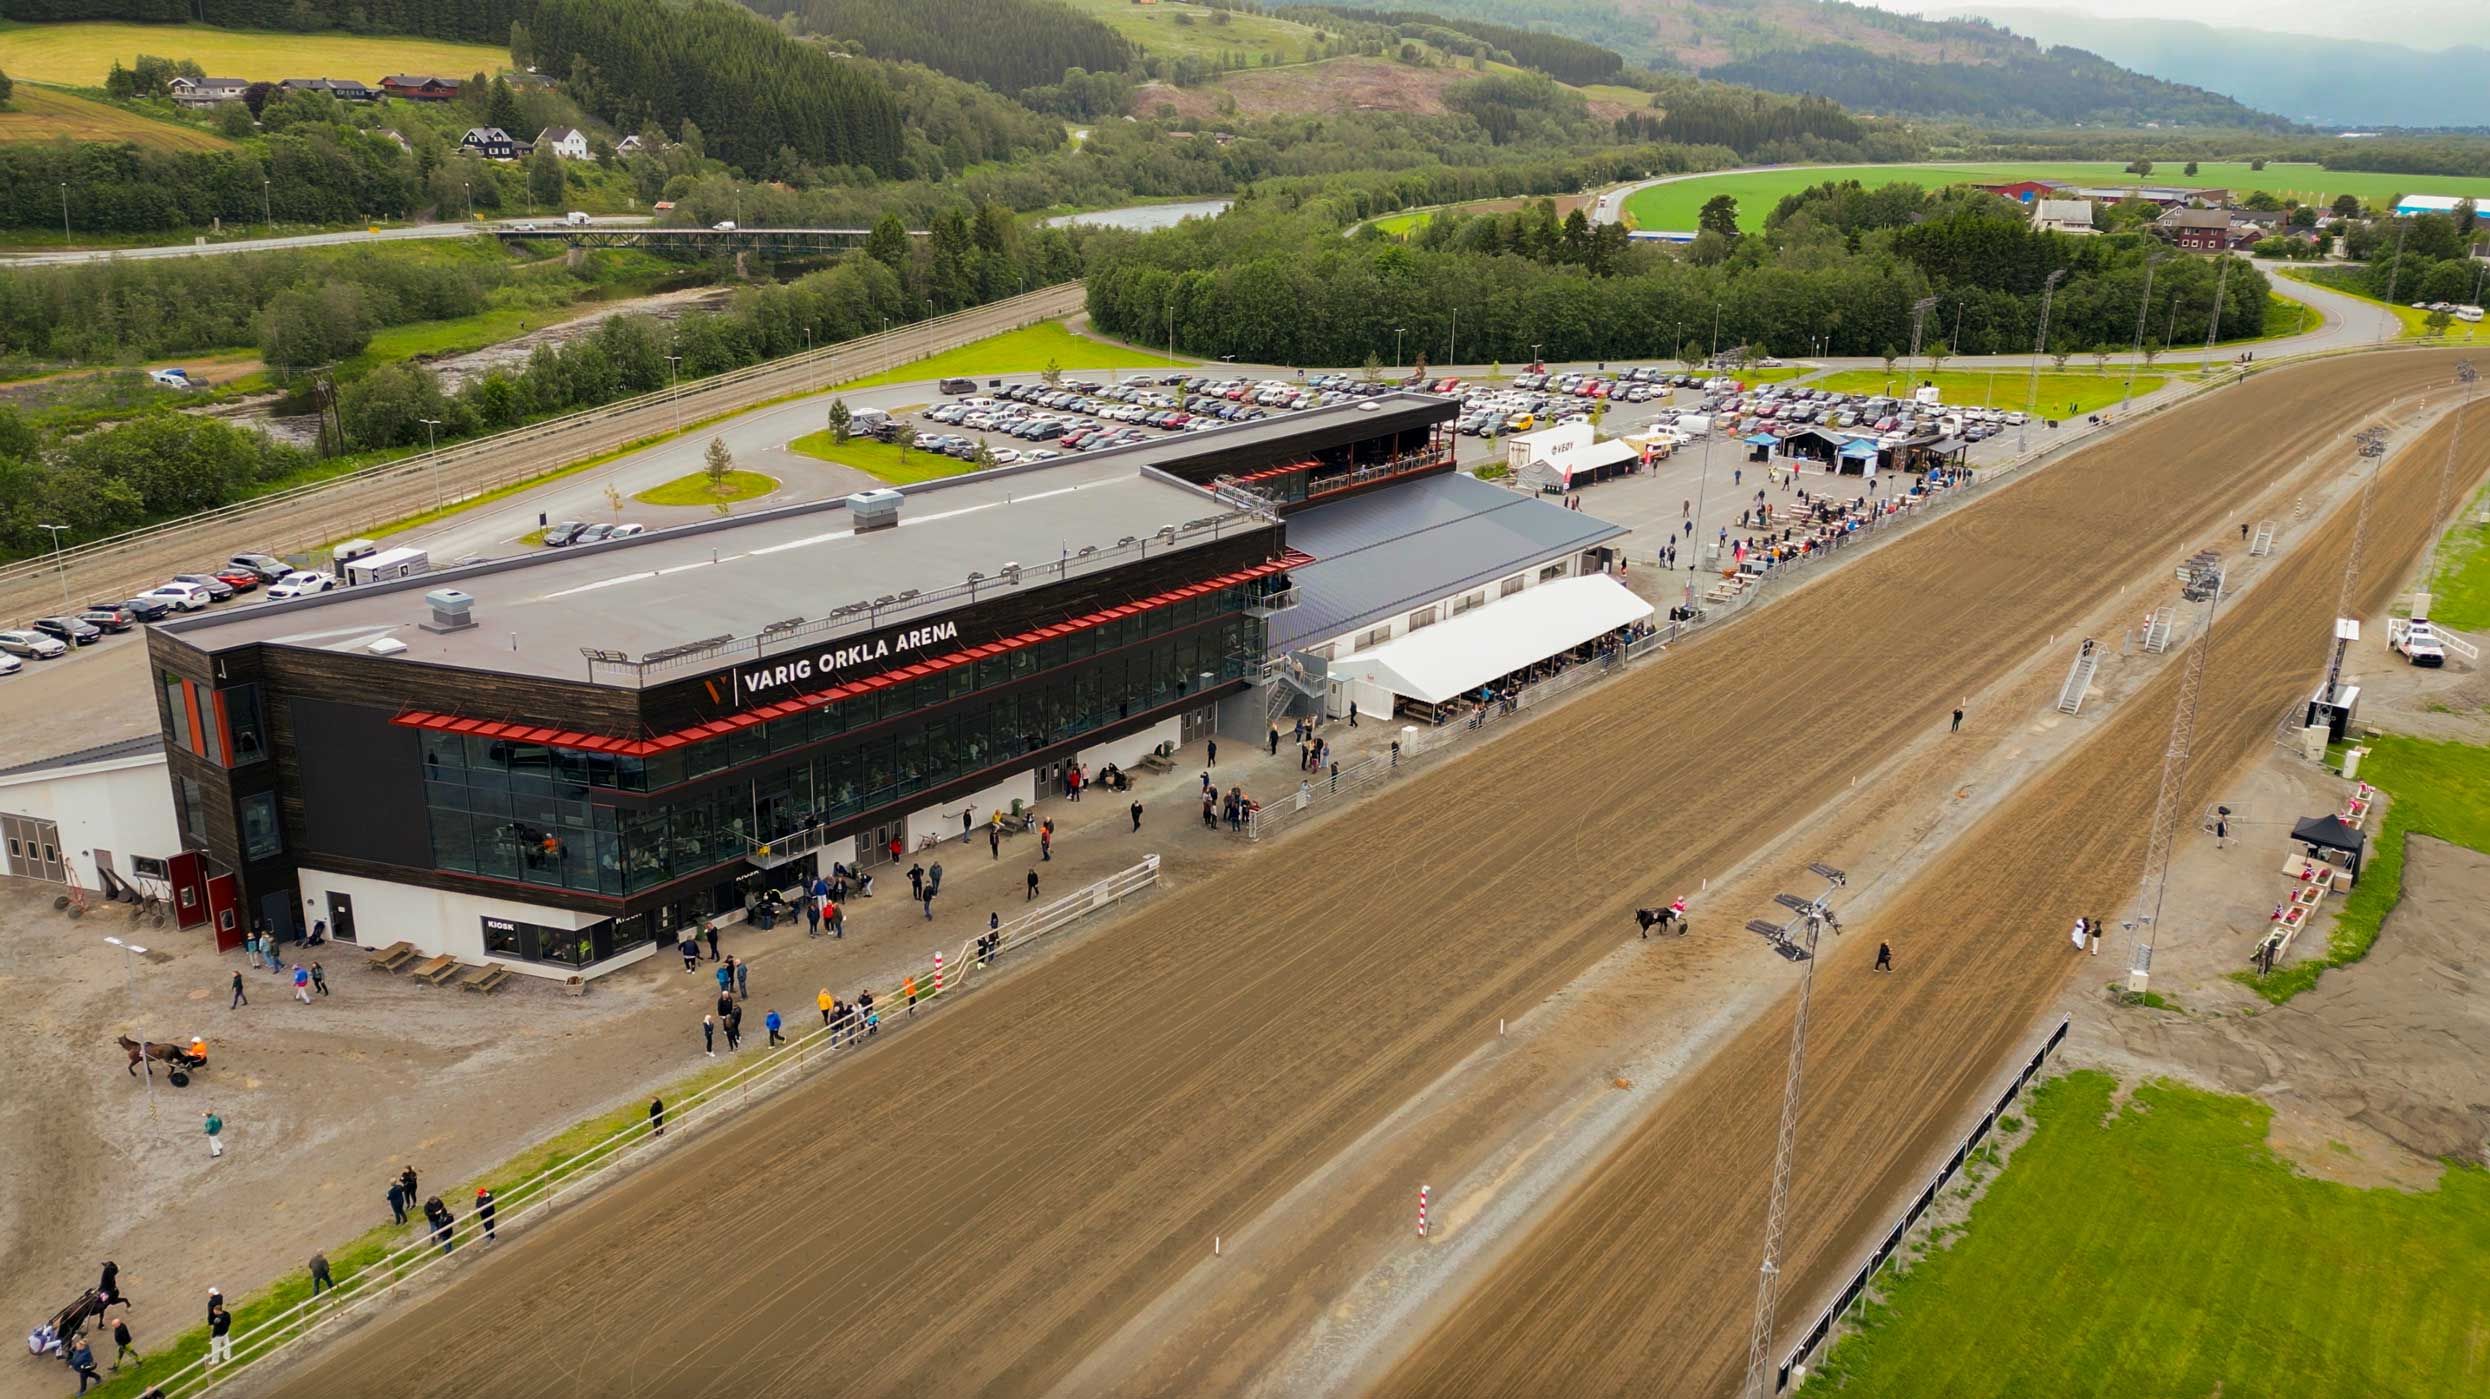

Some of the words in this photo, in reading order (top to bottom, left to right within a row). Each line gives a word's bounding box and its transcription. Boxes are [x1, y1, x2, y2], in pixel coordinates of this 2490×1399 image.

[744, 660, 811, 692] VARIG
[818, 640, 888, 672] ORKLA
[896, 621, 957, 652] ARENA
[487, 920, 514, 931] KIOSK
